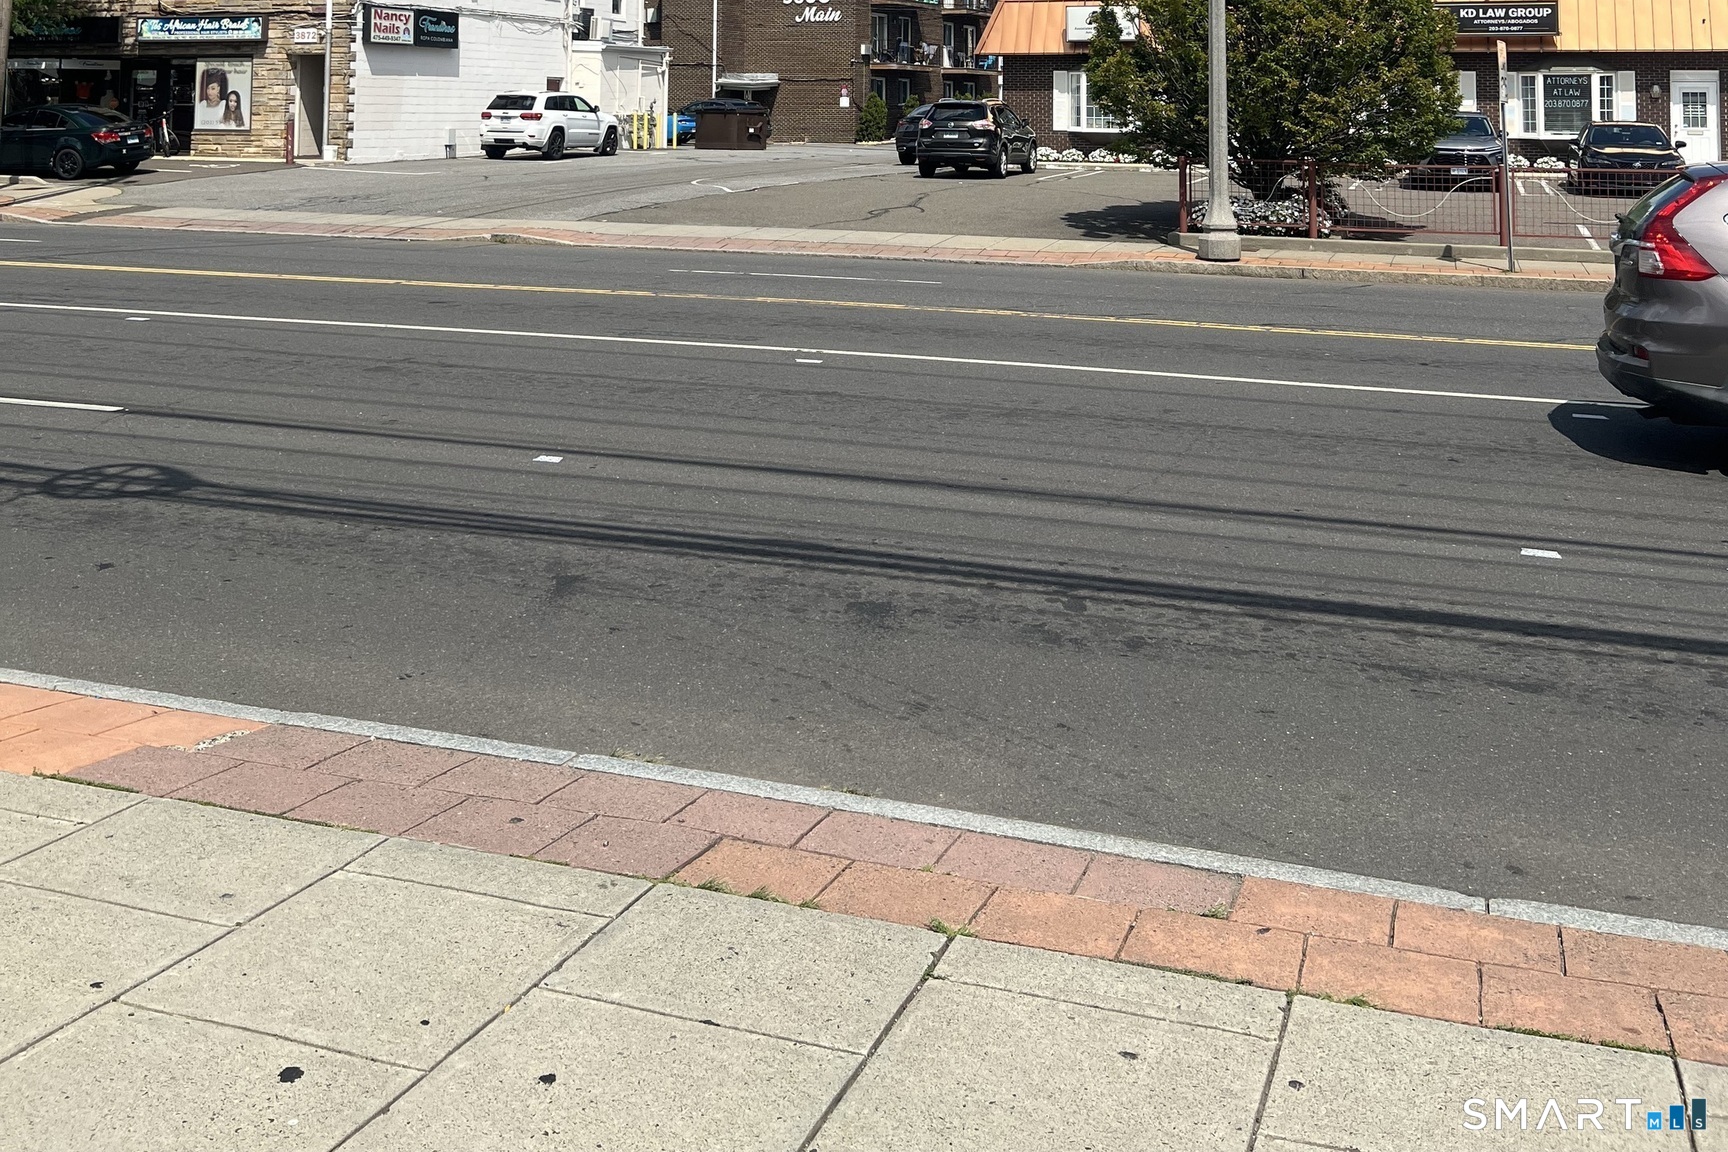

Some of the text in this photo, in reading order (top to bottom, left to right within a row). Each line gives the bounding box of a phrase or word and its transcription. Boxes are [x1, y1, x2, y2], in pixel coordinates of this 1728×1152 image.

[373, 8, 411, 26] Nancy
[795, 6, 843, 23] Main
[1459, 7, 1552, 18] KD LAW GROUP
[162, 18, 198, 35] African
[196, 17, 220, 32] Hair
[373, 22, 401, 35] Nails
[295, 31, 317, 40] 3872
[1546, 76, 1588, 85] ATTORNEYS
[1552, 88, 1581, 97] AT LAW
